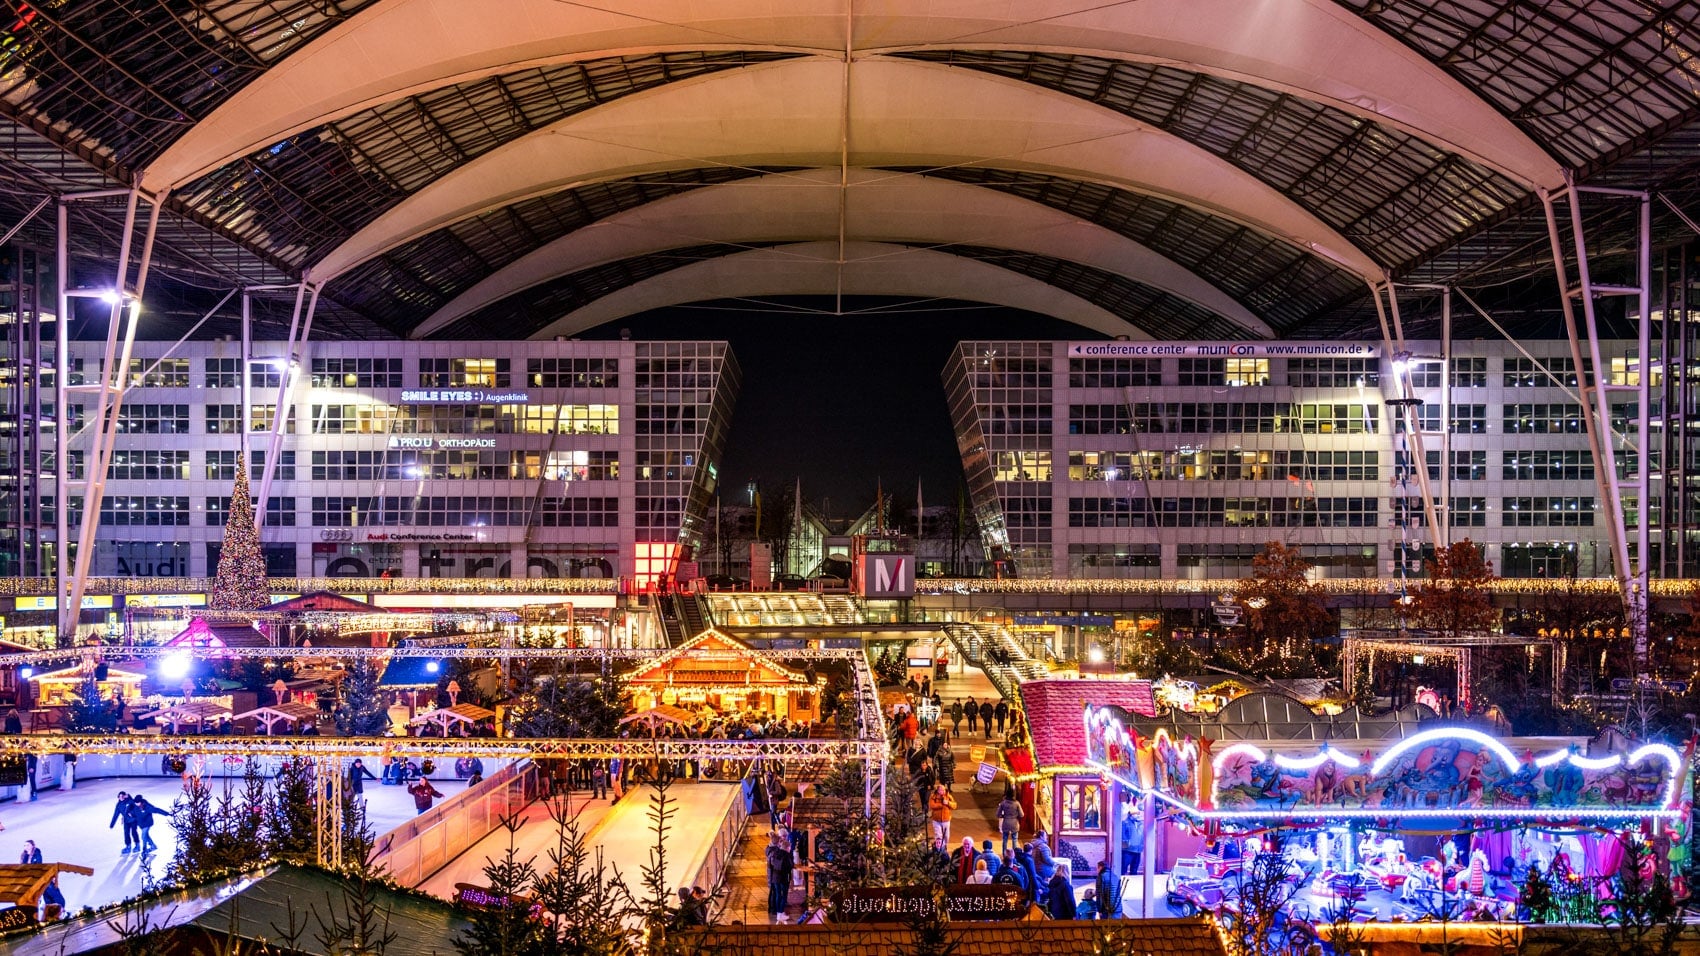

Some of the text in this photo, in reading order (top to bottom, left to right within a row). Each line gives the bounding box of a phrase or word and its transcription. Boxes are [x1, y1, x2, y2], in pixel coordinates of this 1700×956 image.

[1086, 343, 1188, 355] conference center
[1265, 344, 1362, 355] www.municon.de
[401, 390, 439, 401] SMILE
[440, 390, 473, 401] EYES
[485, 393, 528, 403] Augenklinik
[438, 437, 496, 448] ORTHOPÄDIE
[367, 533, 474, 541] Audi Conference Center
[117, 556, 186, 577] Audi
[875, 556, 906, 592] M
